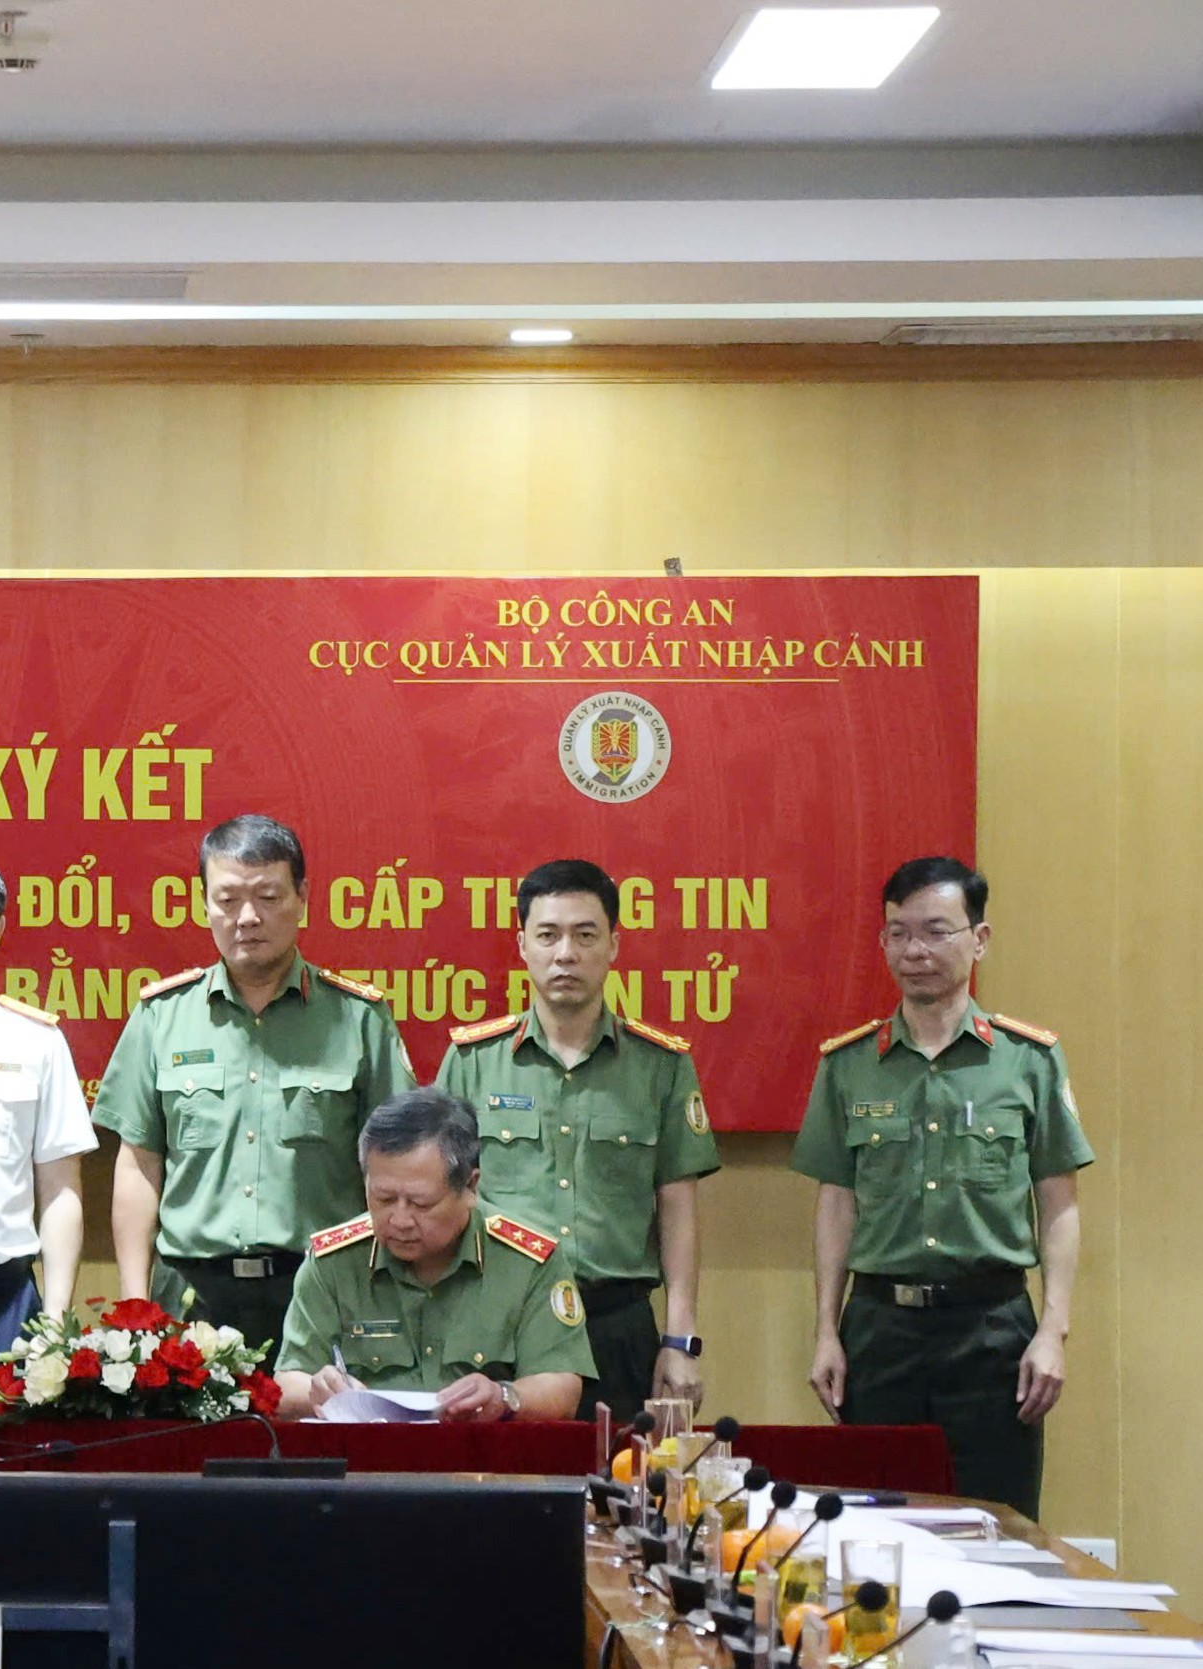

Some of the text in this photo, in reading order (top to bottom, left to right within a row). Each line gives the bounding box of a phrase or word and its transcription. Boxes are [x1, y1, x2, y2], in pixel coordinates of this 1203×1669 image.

[497, 589, 735, 634] BỘ CÔNG AN
[308, 631, 925, 676] CỤC QUẢN LÝ XUẤT NHẬP CẢNH
[83, 723, 213, 821] KẾT
[572, 770, 656, 798] IMMIGRATION
[16, 854, 131, 935] ĐỔI,
[329, 858, 444, 930] CẤP
[673, 877, 768, 930] TIN
[662, 952, 739, 1023] TỬ
